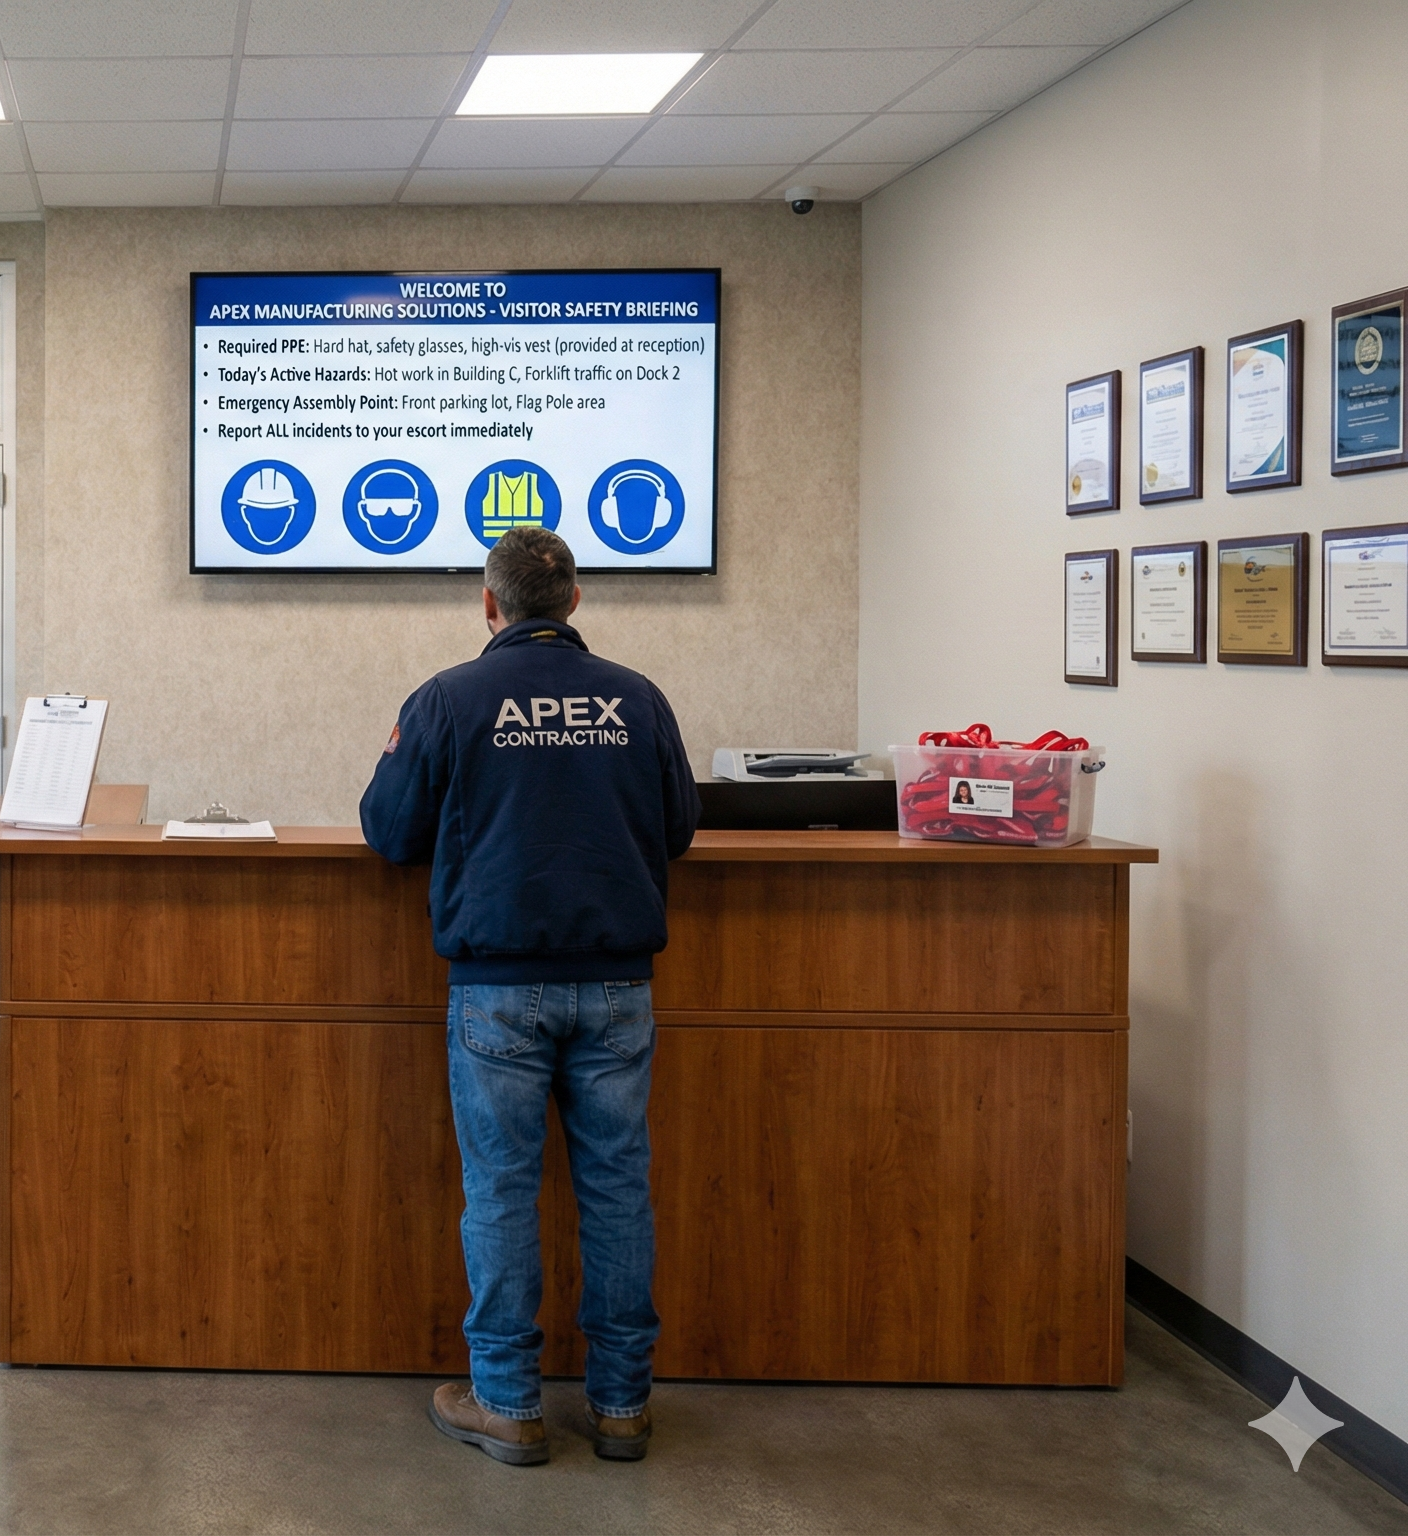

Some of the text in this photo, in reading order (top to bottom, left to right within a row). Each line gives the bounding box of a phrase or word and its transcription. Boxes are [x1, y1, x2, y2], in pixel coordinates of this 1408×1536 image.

[399, 282, 507, 299] WELCOME TO
[209, 304, 250, 320] APEX
[254, 302, 394, 320] MANUFACTURING
[397, 302, 486, 319] SOLUTIONS
[499, 302, 562, 318] VISITOR
[565, 302, 622, 318] SAFETY
[626, 301, 699, 317] BRIEFING
[218, 336, 705, 358] Required PPE: Hard hat, safety glasses, high-vis vest (provided at reception)
[269, 366, 312, 382] Active
[314, 365, 371, 382] Hazards:
[374, 366, 398, 382] Hot
[401, 365, 435, 382] work
[437, 366, 450, 381] in
[453, 365, 506, 385] Building
[508, 365, 521, 384] C,
[525, 364, 571, 381] Forklift
[573, 364, 613, 382] traffic
[615, 368, 633, 381] on
[636, 364, 669, 381] Dock
[672, 365, 681, 381] 2
[218, 393, 606, 414] Emergency Assembly Point: Front parking lot, Flag Pole area
[218, 421, 534, 442] Report ALL incidents to your escort immediately
[493, 696, 627, 729] APEX
[493, 729, 629, 748] CONTRACTING
